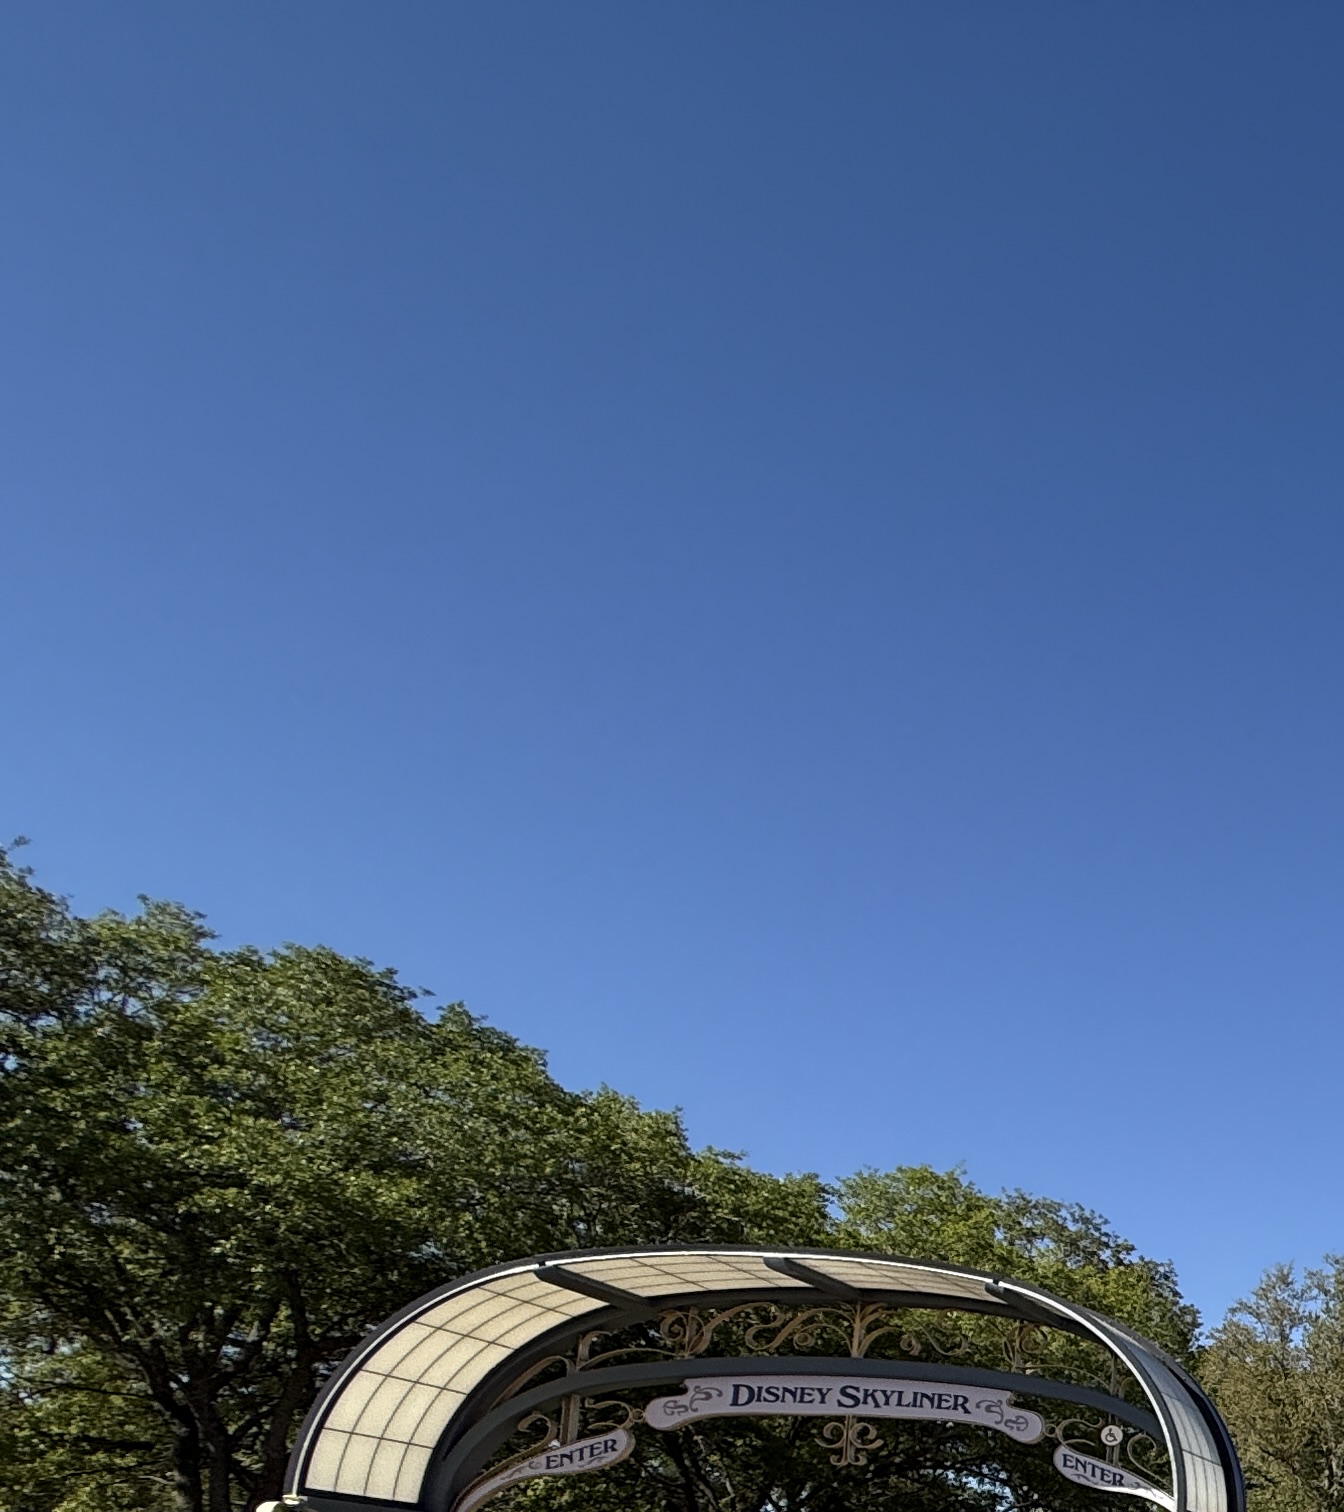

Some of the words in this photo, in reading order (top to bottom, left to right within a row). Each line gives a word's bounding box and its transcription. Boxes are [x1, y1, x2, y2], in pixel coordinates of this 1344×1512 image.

[729, 1383, 833, 1407] DISNEY
[836, 1384, 972, 1414] SKYLINER
[545, 1438, 618, 1470] ENTER
[1061, 1453, 1125, 1487] ENTER
